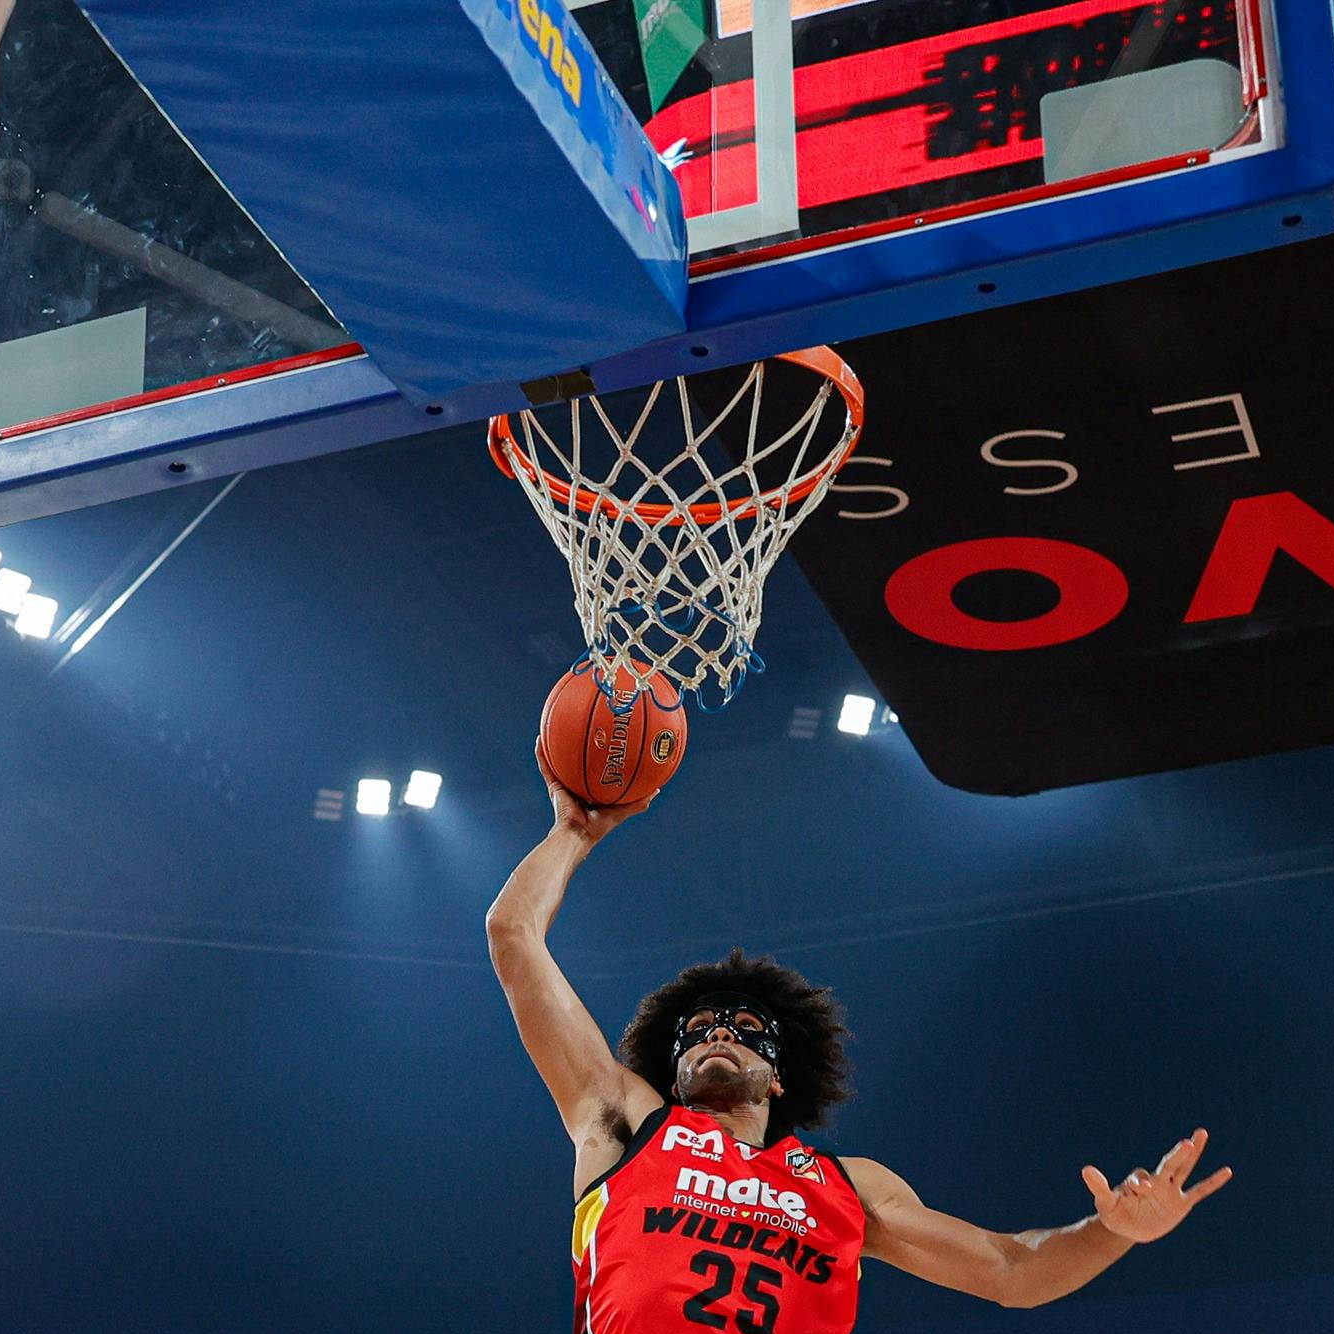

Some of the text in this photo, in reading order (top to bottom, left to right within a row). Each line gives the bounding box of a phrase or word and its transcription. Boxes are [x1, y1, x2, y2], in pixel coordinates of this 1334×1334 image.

[691, 1148, 723, 1163] bank
[672, 1192, 809, 1237] internet mobile
[642, 1206, 838, 1285] WILDCATS
